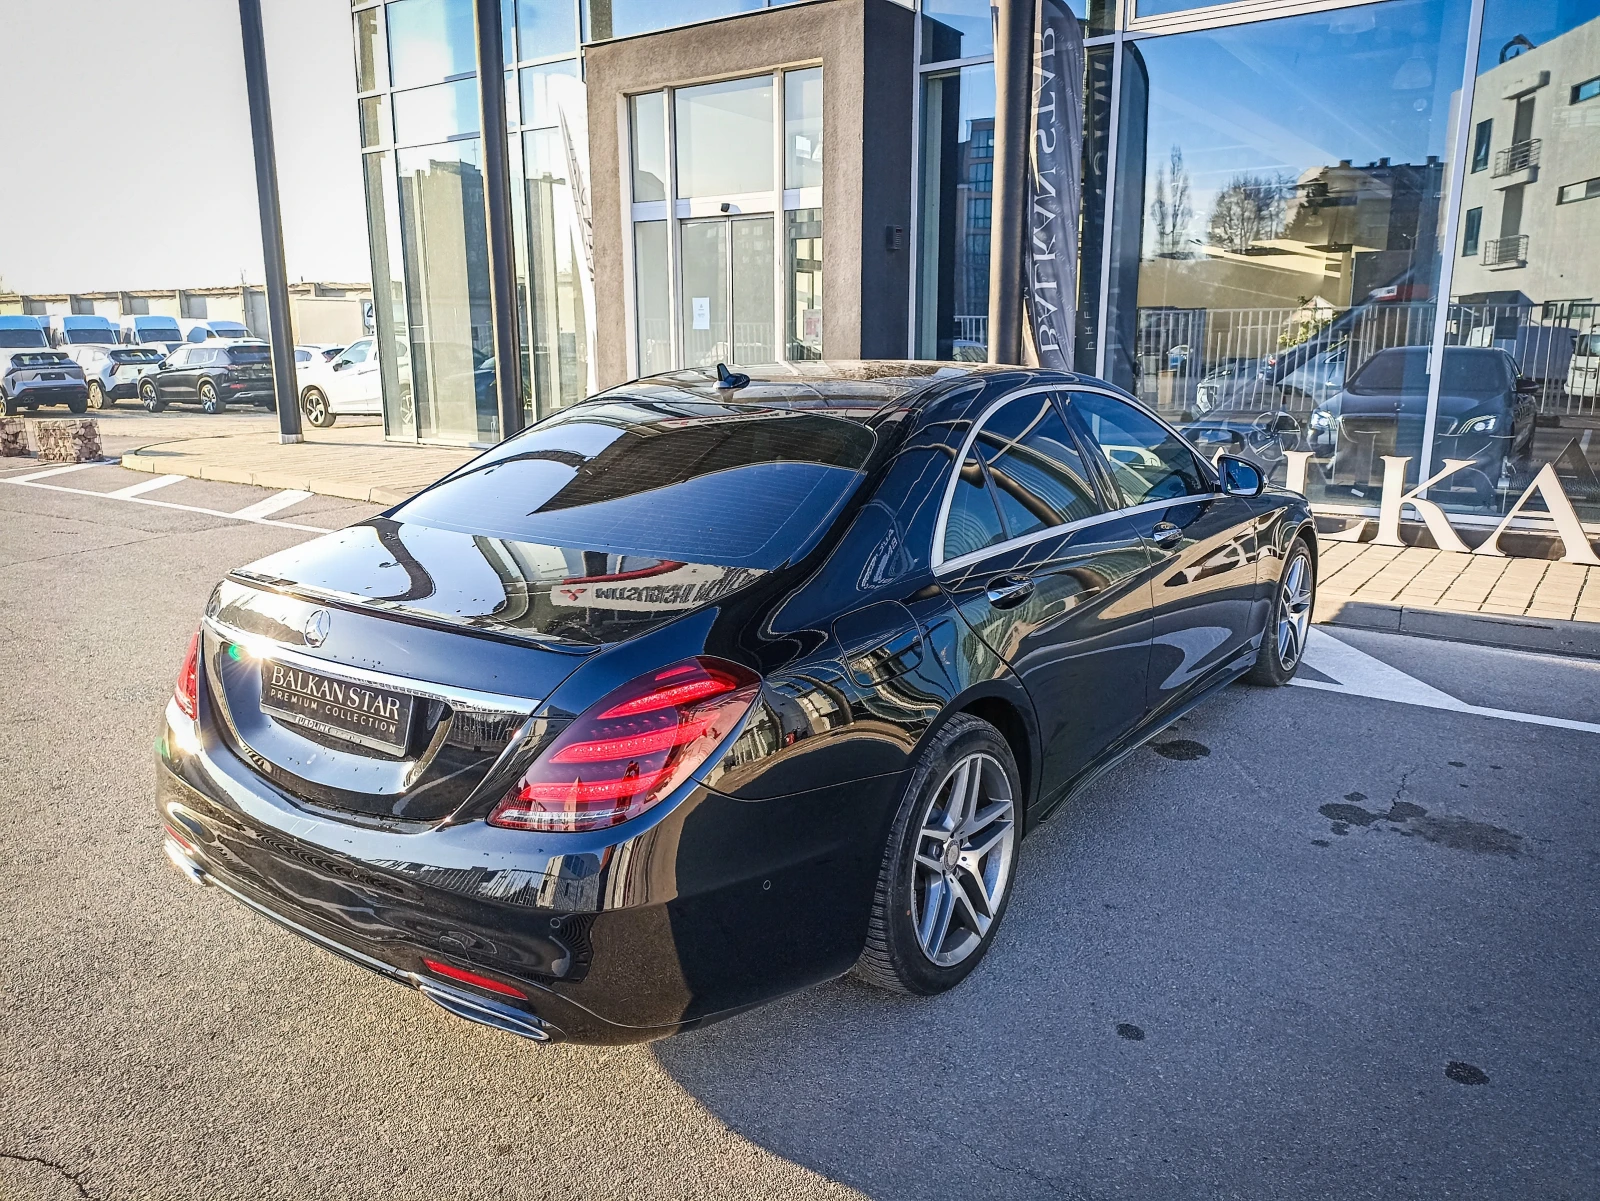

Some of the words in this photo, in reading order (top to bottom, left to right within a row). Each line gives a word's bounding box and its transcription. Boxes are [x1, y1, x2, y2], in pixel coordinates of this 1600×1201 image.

[1211, 446, 1600, 566] LKA
[270, 688, 318, 710] PREMIUM
[325, 705, 397, 734] COLLECTION
[271, 665, 346, 704] BALKAN
[347, 687, 400, 720] STAR
